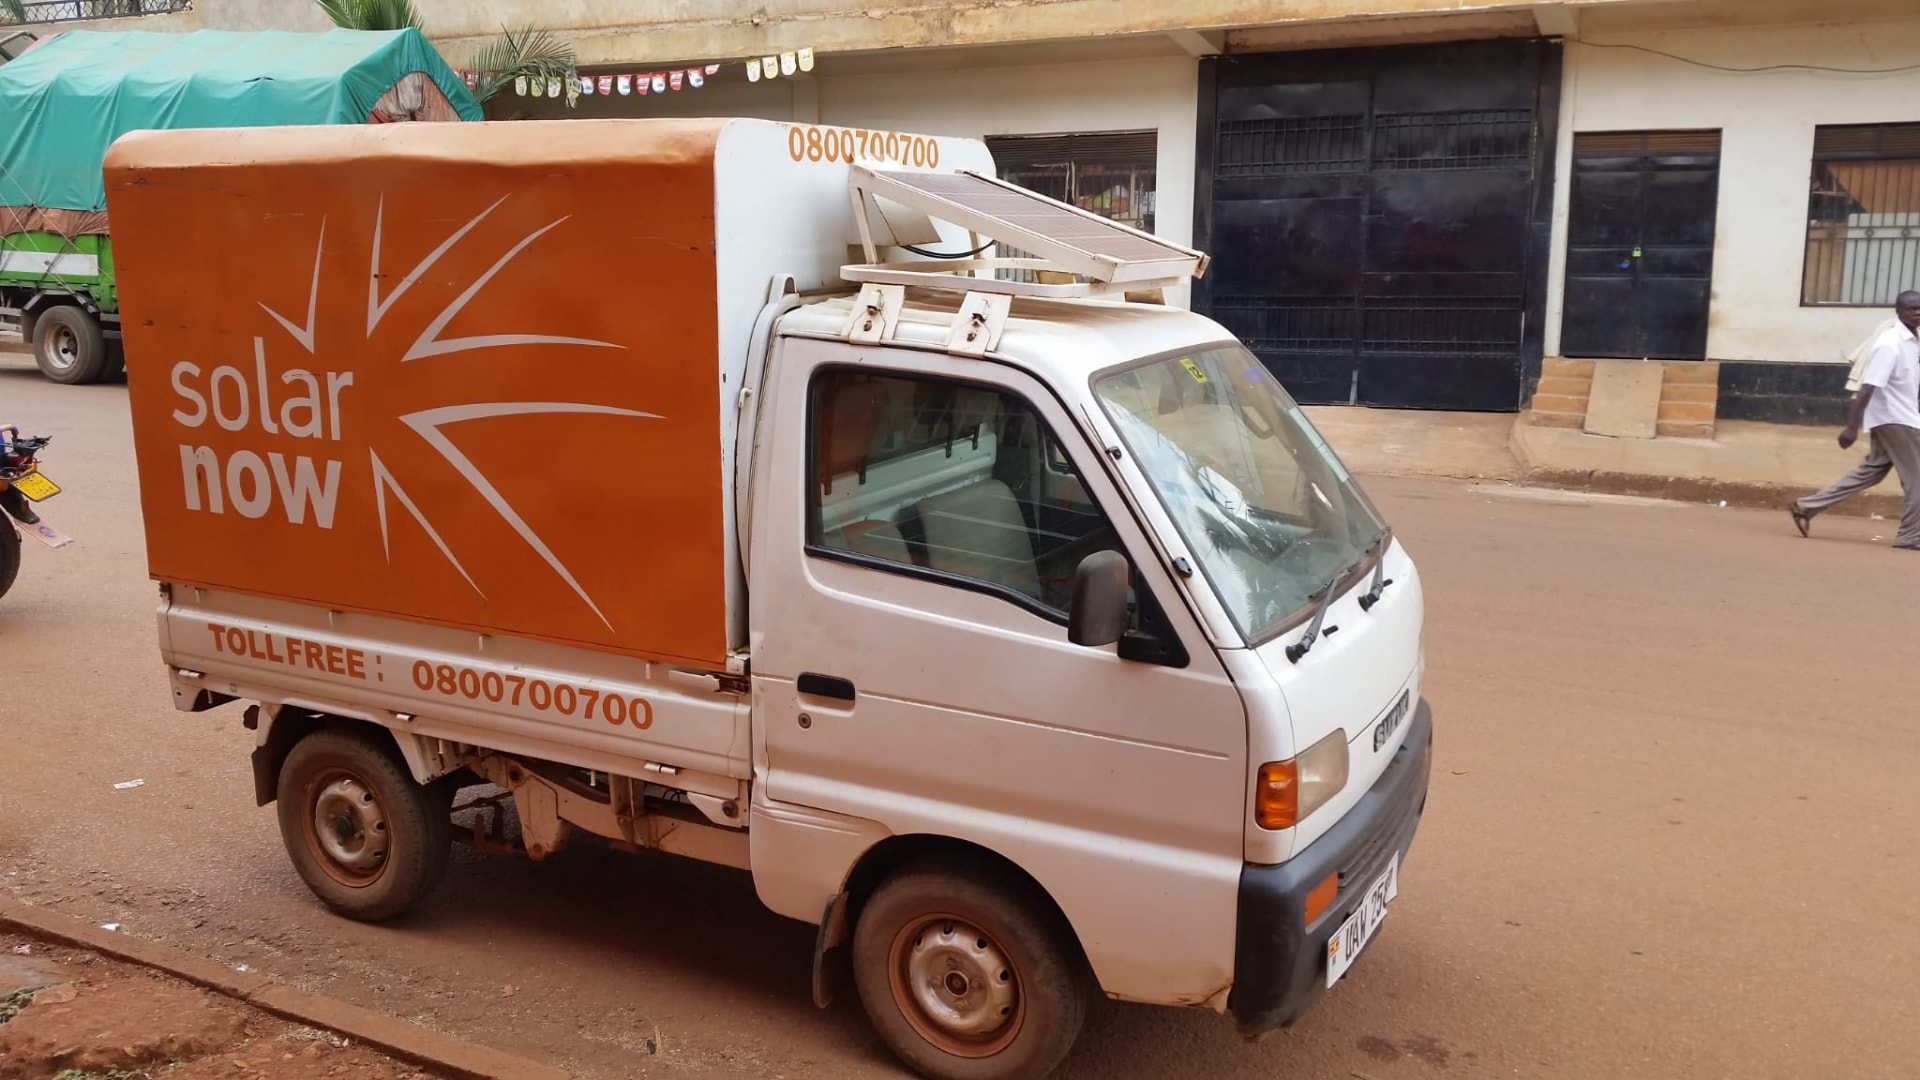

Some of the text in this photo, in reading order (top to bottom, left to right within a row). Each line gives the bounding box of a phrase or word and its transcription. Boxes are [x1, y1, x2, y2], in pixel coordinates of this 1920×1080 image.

[788, 126, 939, 169] 0800700700
[171, 336, 354, 441] solar
[179, 444, 343, 530] now
[412, 659, 653, 731] 0800700700
